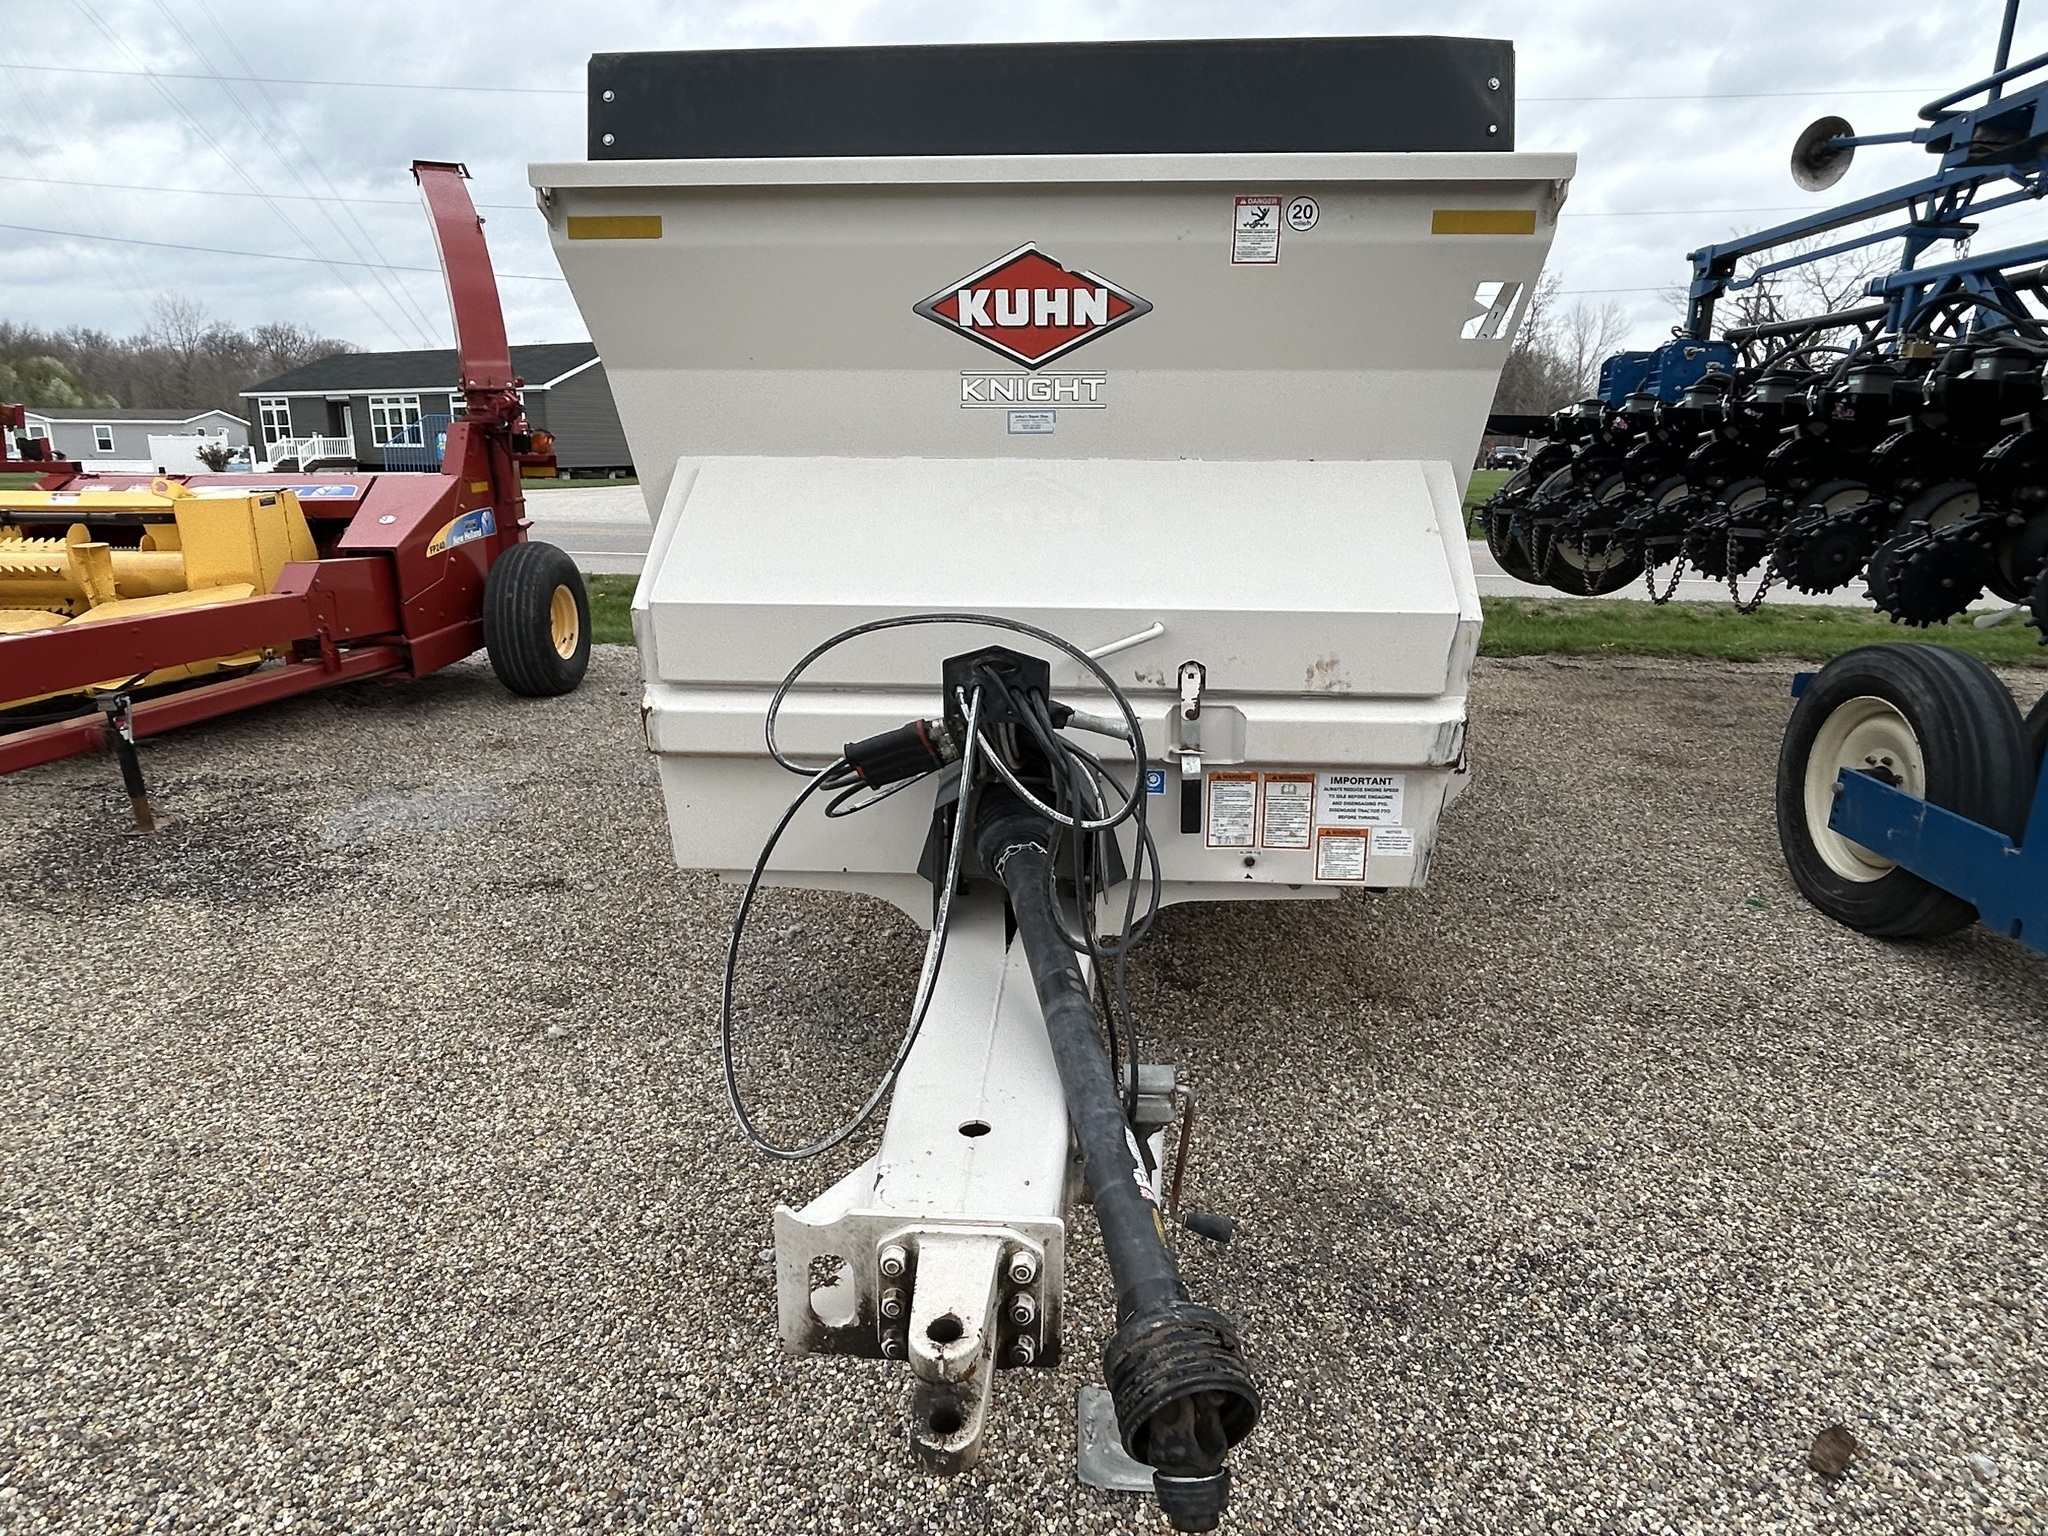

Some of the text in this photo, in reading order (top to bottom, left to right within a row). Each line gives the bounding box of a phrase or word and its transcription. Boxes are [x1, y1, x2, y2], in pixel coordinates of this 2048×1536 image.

[1292, 204, 1313, 219] 20
[957, 288, 1108, 326] KUHN
[961, 377, 1107, 400] KNIGHT
[1330, 777, 1393, 785] IMPORTANT
